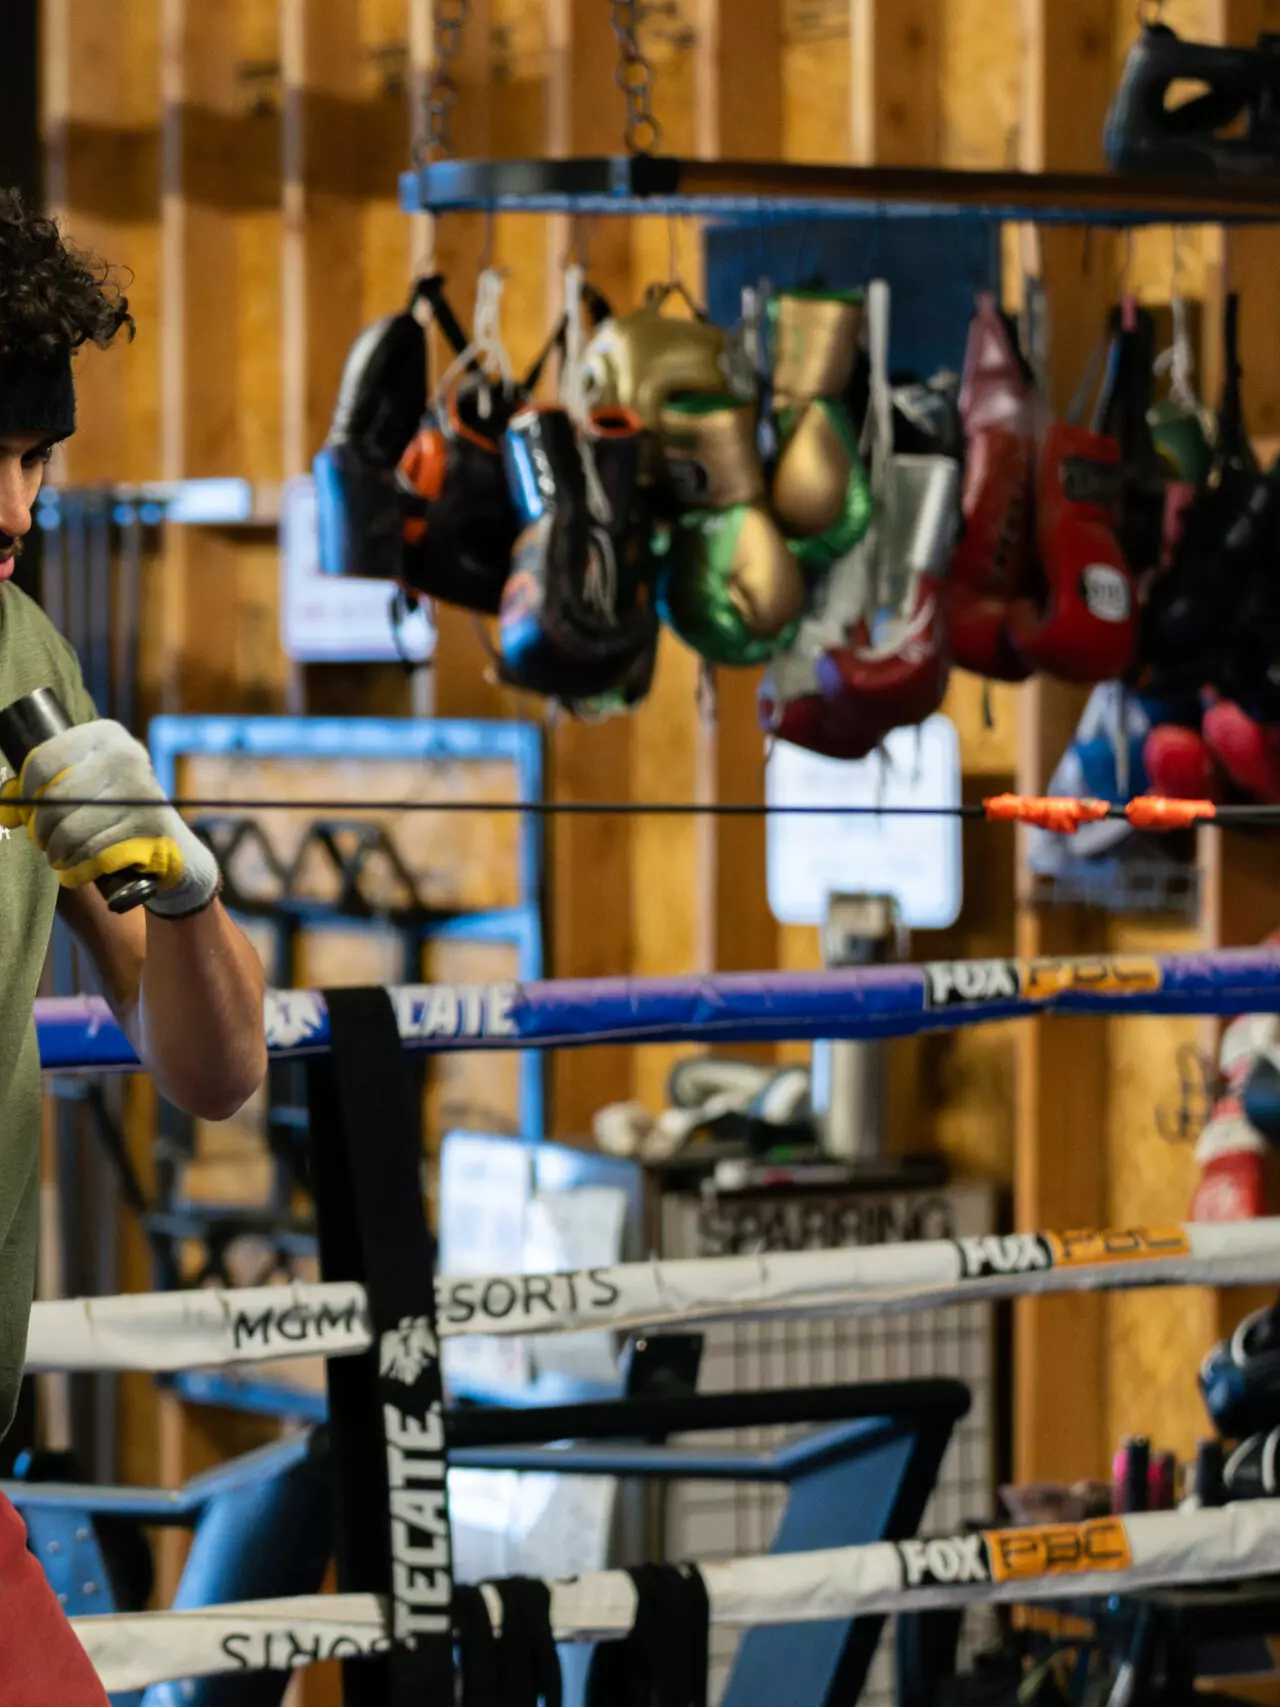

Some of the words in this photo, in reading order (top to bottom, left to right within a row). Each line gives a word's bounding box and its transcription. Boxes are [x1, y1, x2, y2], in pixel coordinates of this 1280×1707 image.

[388, 983, 523, 1038] CATE
[234, 1297, 356, 1349] MGM
[436, 1268, 619, 1323] SORTS
[384, 1402, 452, 1640] TECATE
[901, 1534, 988, 1586] FOX
[1001, 1525, 1125, 1570] PBC
